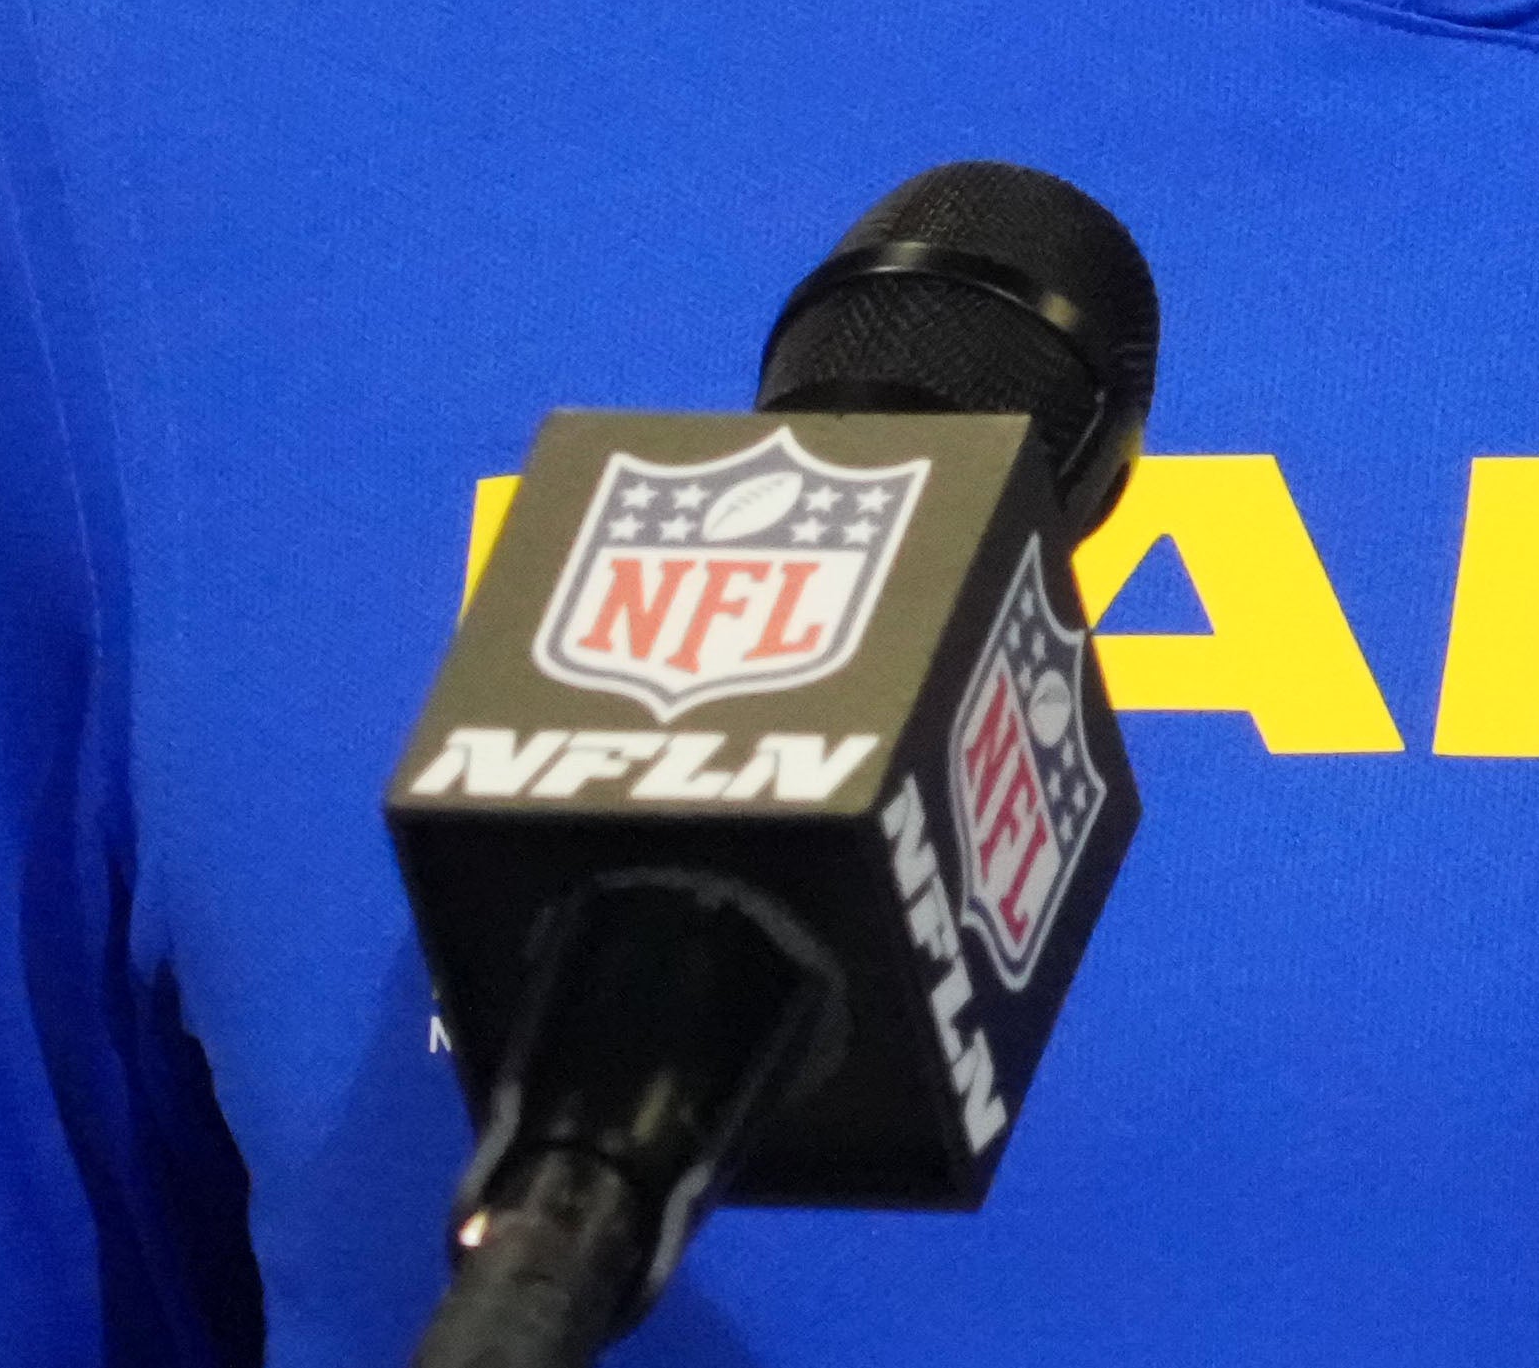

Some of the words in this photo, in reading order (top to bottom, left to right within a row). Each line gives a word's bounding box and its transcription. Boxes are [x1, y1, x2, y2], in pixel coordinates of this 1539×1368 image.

[576, 557, 825, 675] NFL
[408, 727, 881, 803] NFLN
[965, 671, 1050, 947] NFL
[880, 771, 1009, 1156] NFLN
